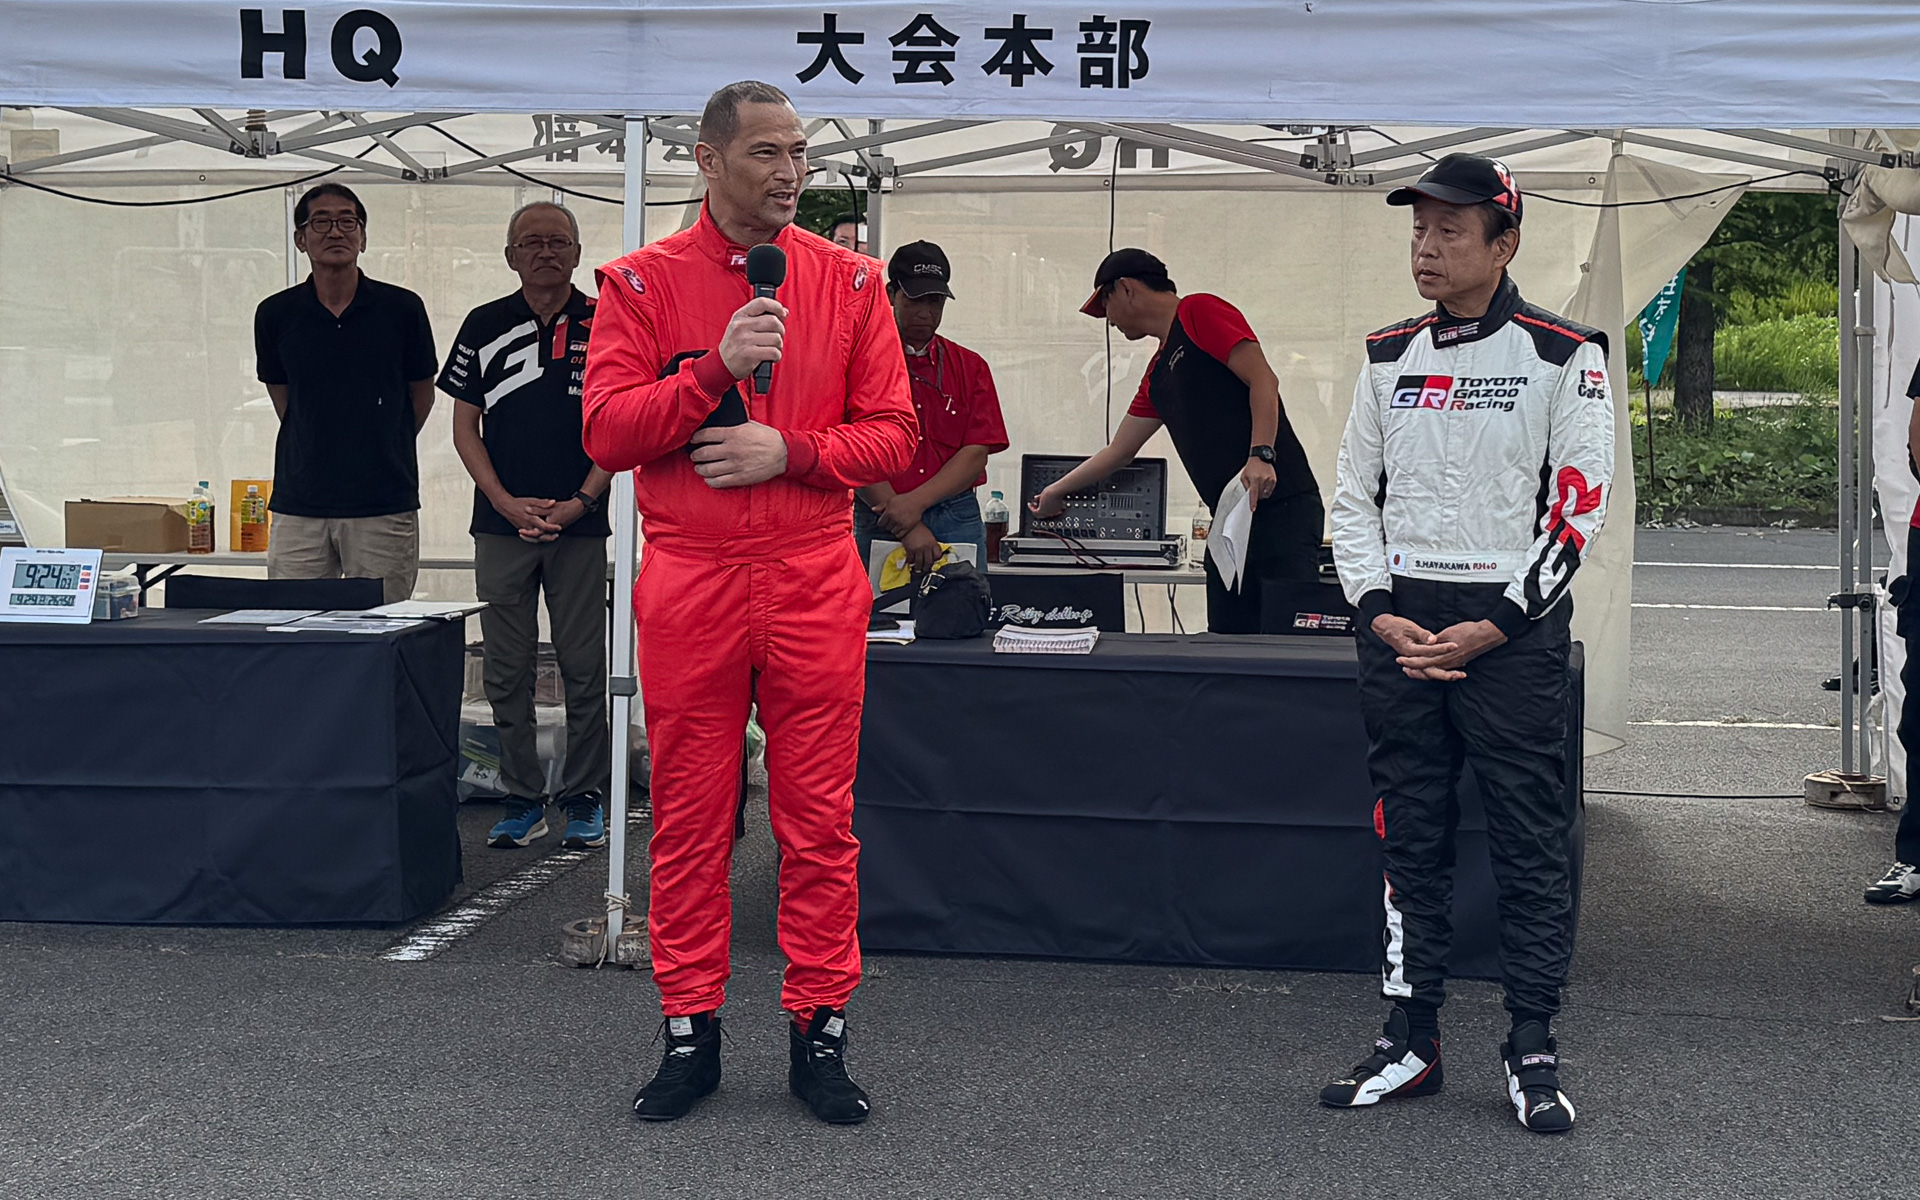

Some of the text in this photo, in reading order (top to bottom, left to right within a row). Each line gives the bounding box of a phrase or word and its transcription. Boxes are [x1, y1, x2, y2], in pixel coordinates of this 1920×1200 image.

[795, 13, 1152, 88] 大会本部
[1457, 376, 1529, 388] TOYOTA
[1391, 387, 1447, 410] GR
[1452, 388, 1519, 399] GAZOO
[1578, 383, 1605, 400] Cars
[1449, 398, 1516, 412] Racing
[1414, 560, 1471, 571] S.HAYAKAWA
